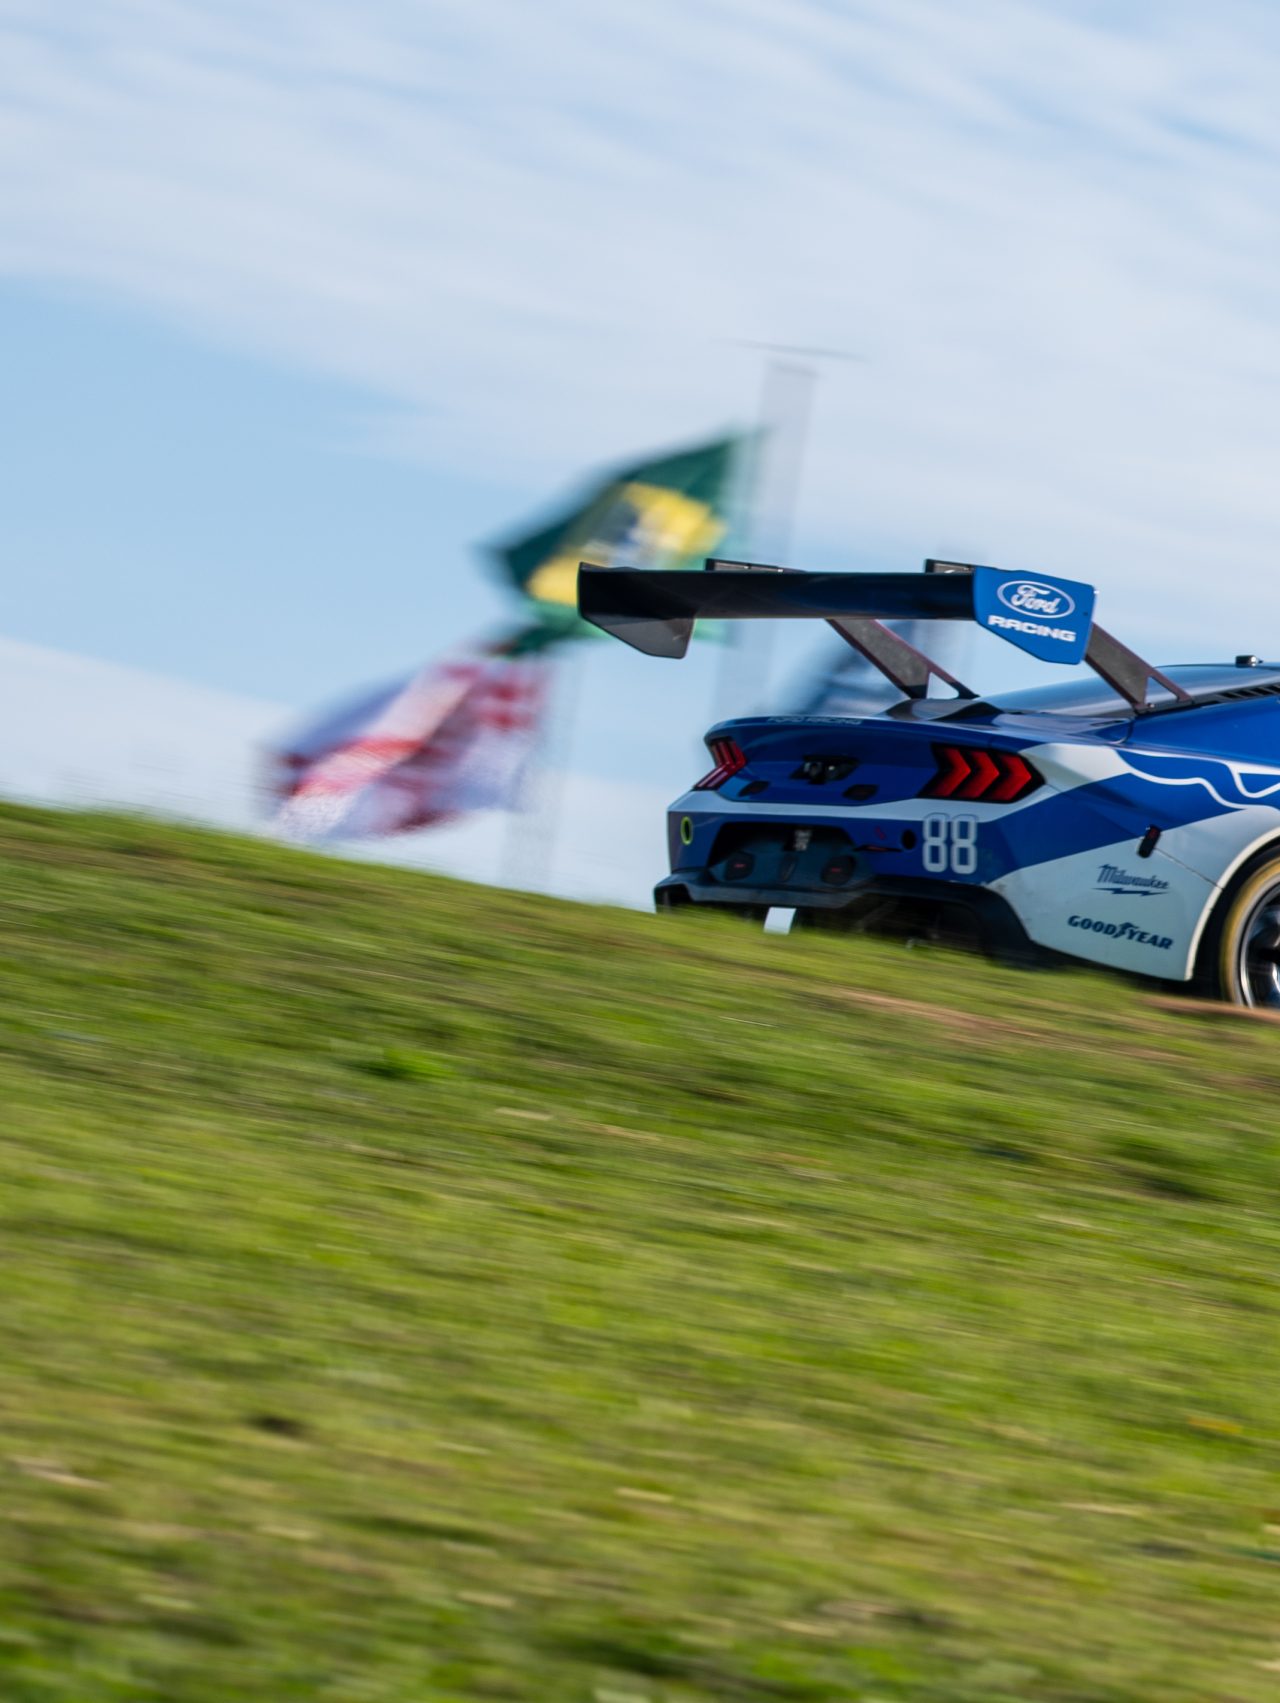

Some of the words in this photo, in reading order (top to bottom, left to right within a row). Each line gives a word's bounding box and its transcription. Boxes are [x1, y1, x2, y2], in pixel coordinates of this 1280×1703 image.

[1010, 584, 1061, 614] Ford
[987, 615, 1077, 642] RACING
[922, 812, 978, 875] 88
[1097, 864, 1169, 889] Milwaukee
